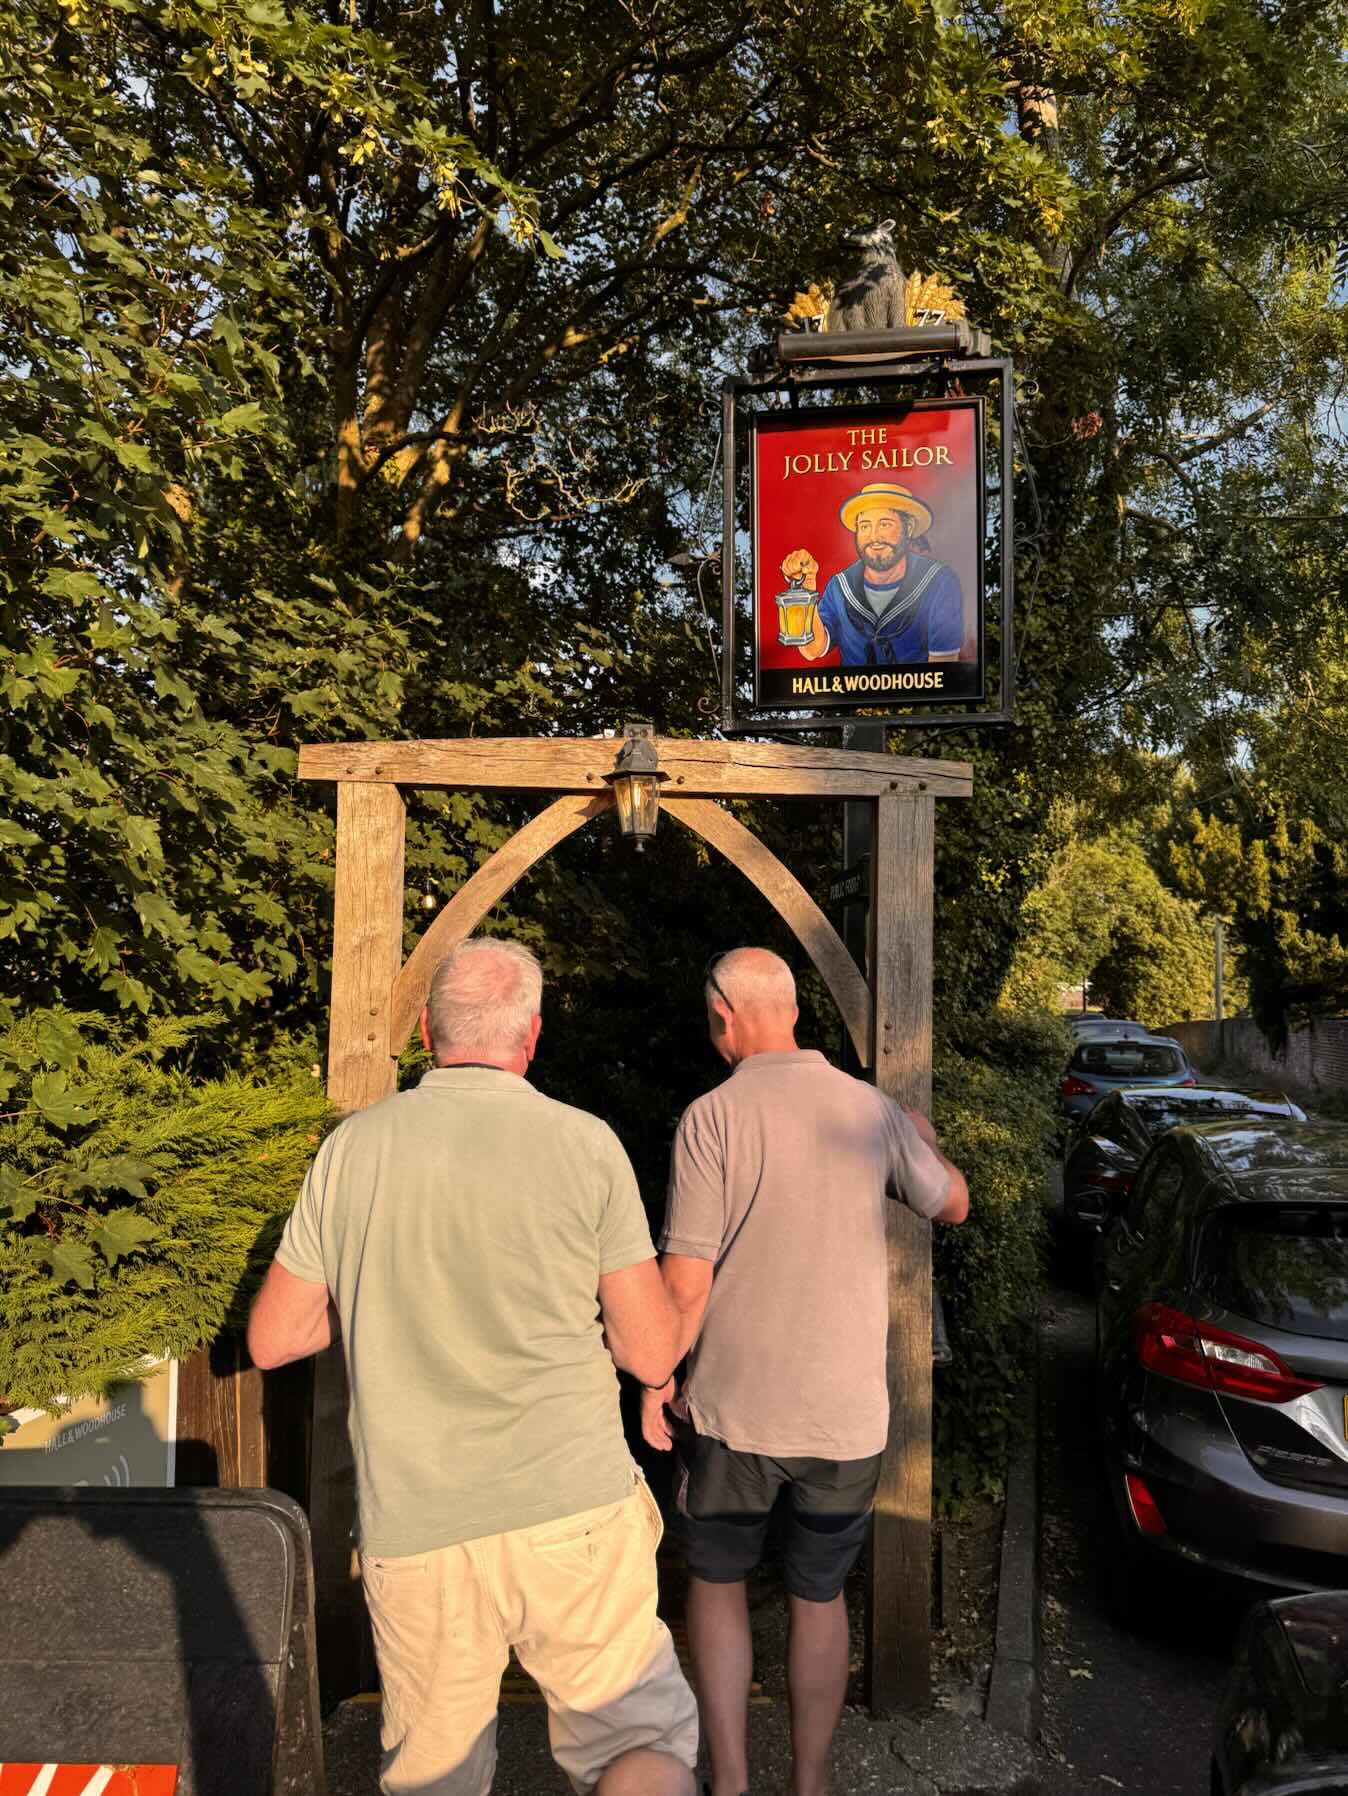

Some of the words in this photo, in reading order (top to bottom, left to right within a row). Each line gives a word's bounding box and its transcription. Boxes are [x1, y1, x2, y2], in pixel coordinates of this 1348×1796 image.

[847, 428, 888, 446] THE
[783, 451, 854, 480] JOLLY
[861, 446, 953, 471] SAILOR
